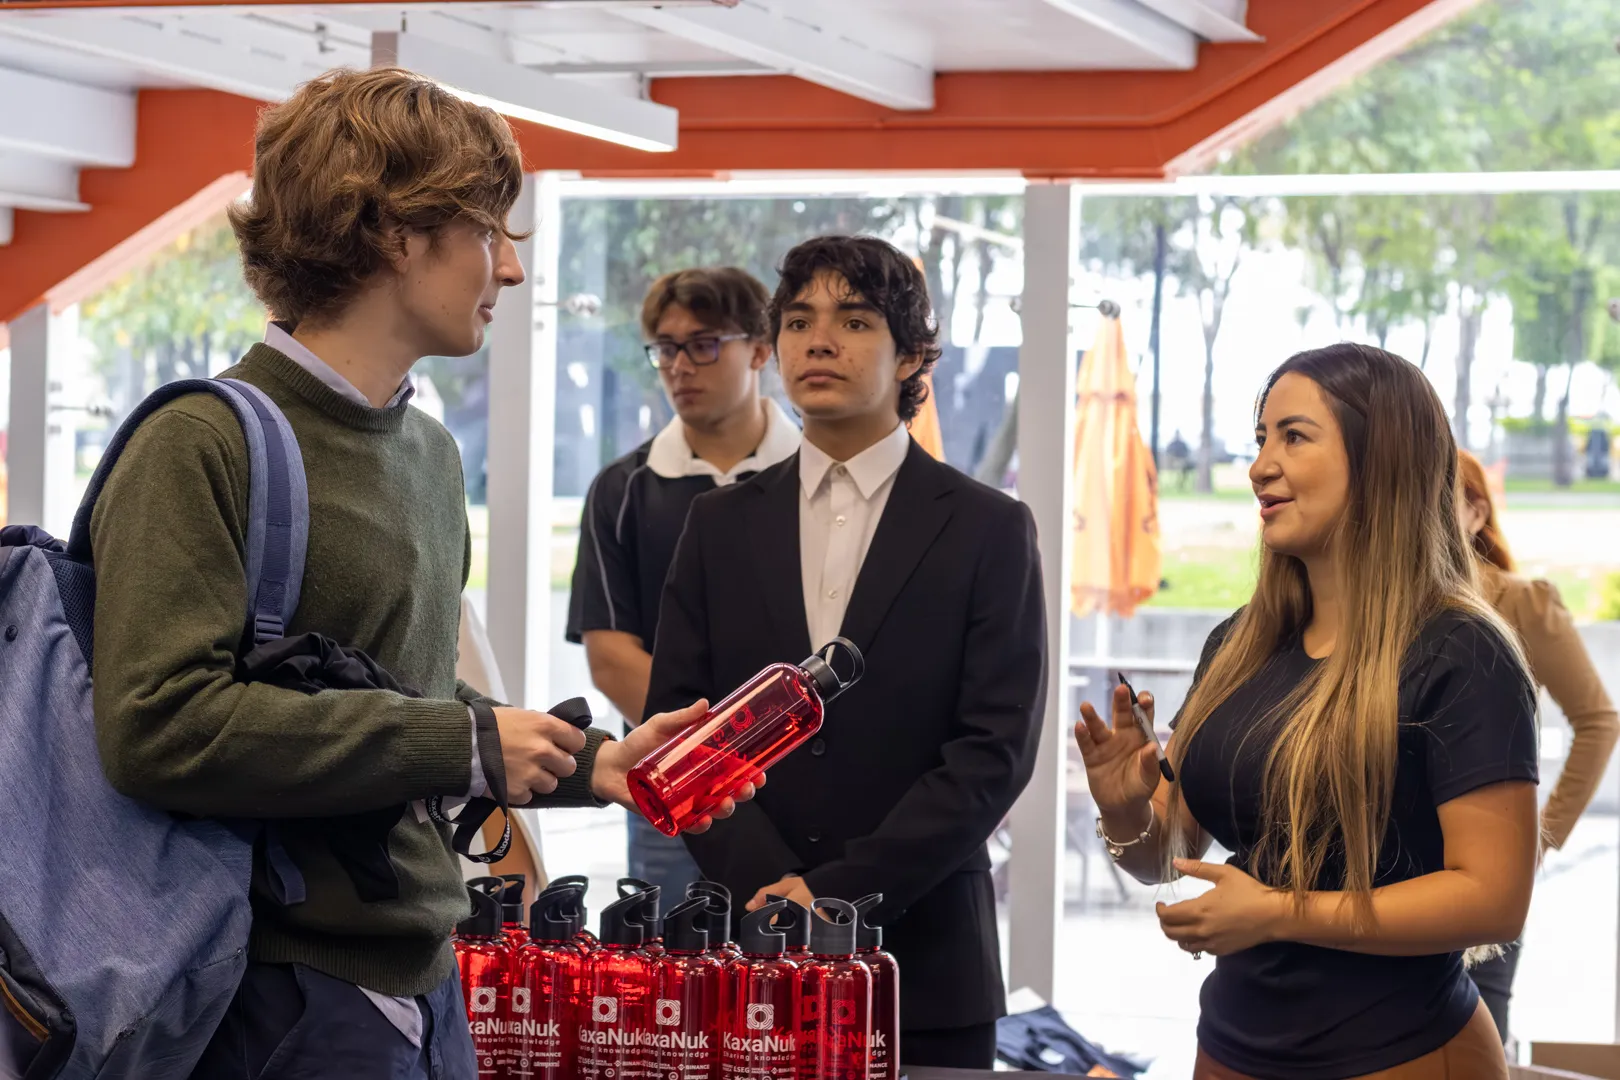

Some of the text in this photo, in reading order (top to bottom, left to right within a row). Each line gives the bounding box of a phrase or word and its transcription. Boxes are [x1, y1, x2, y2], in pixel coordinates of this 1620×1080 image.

[723, 1031, 796, 1053] KaxaNuk
[598, 1046, 641, 1056] knowledg
[661, 1050, 709, 1059] knowledge
[733, 1065, 750, 1074] LSEG
